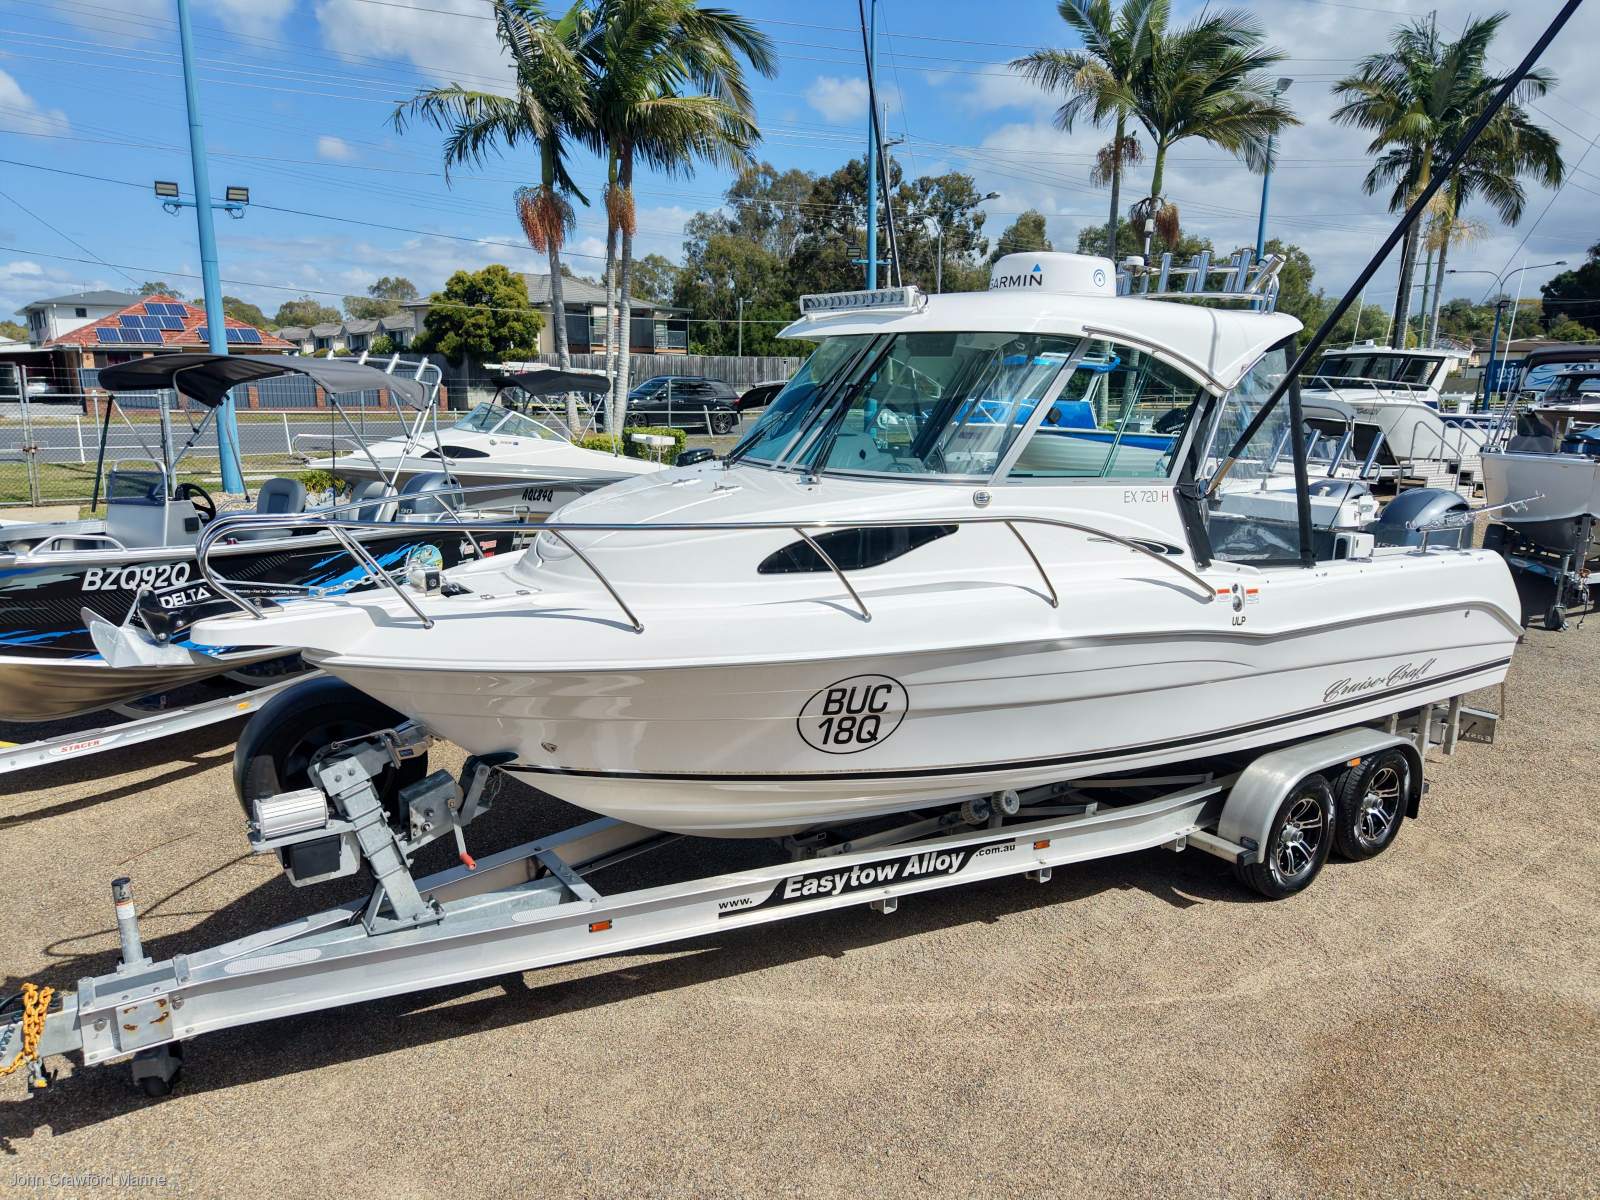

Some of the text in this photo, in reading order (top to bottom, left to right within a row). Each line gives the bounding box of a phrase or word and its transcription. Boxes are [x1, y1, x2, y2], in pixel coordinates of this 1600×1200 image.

[521, 488, 554, 503] AQL84Q
[1123, 490, 1169, 504] EX 720 H
[81, 562, 191, 591] BZQ92Q
[159, 585, 212, 609] DELTA
[1231, 616, 1247, 626] ULP
[822, 684, 893, 716] BUC
[818, 715, 881, 745] 18Q
[718, 843, 1016, 910] www. Easytow Alloy .com.au
